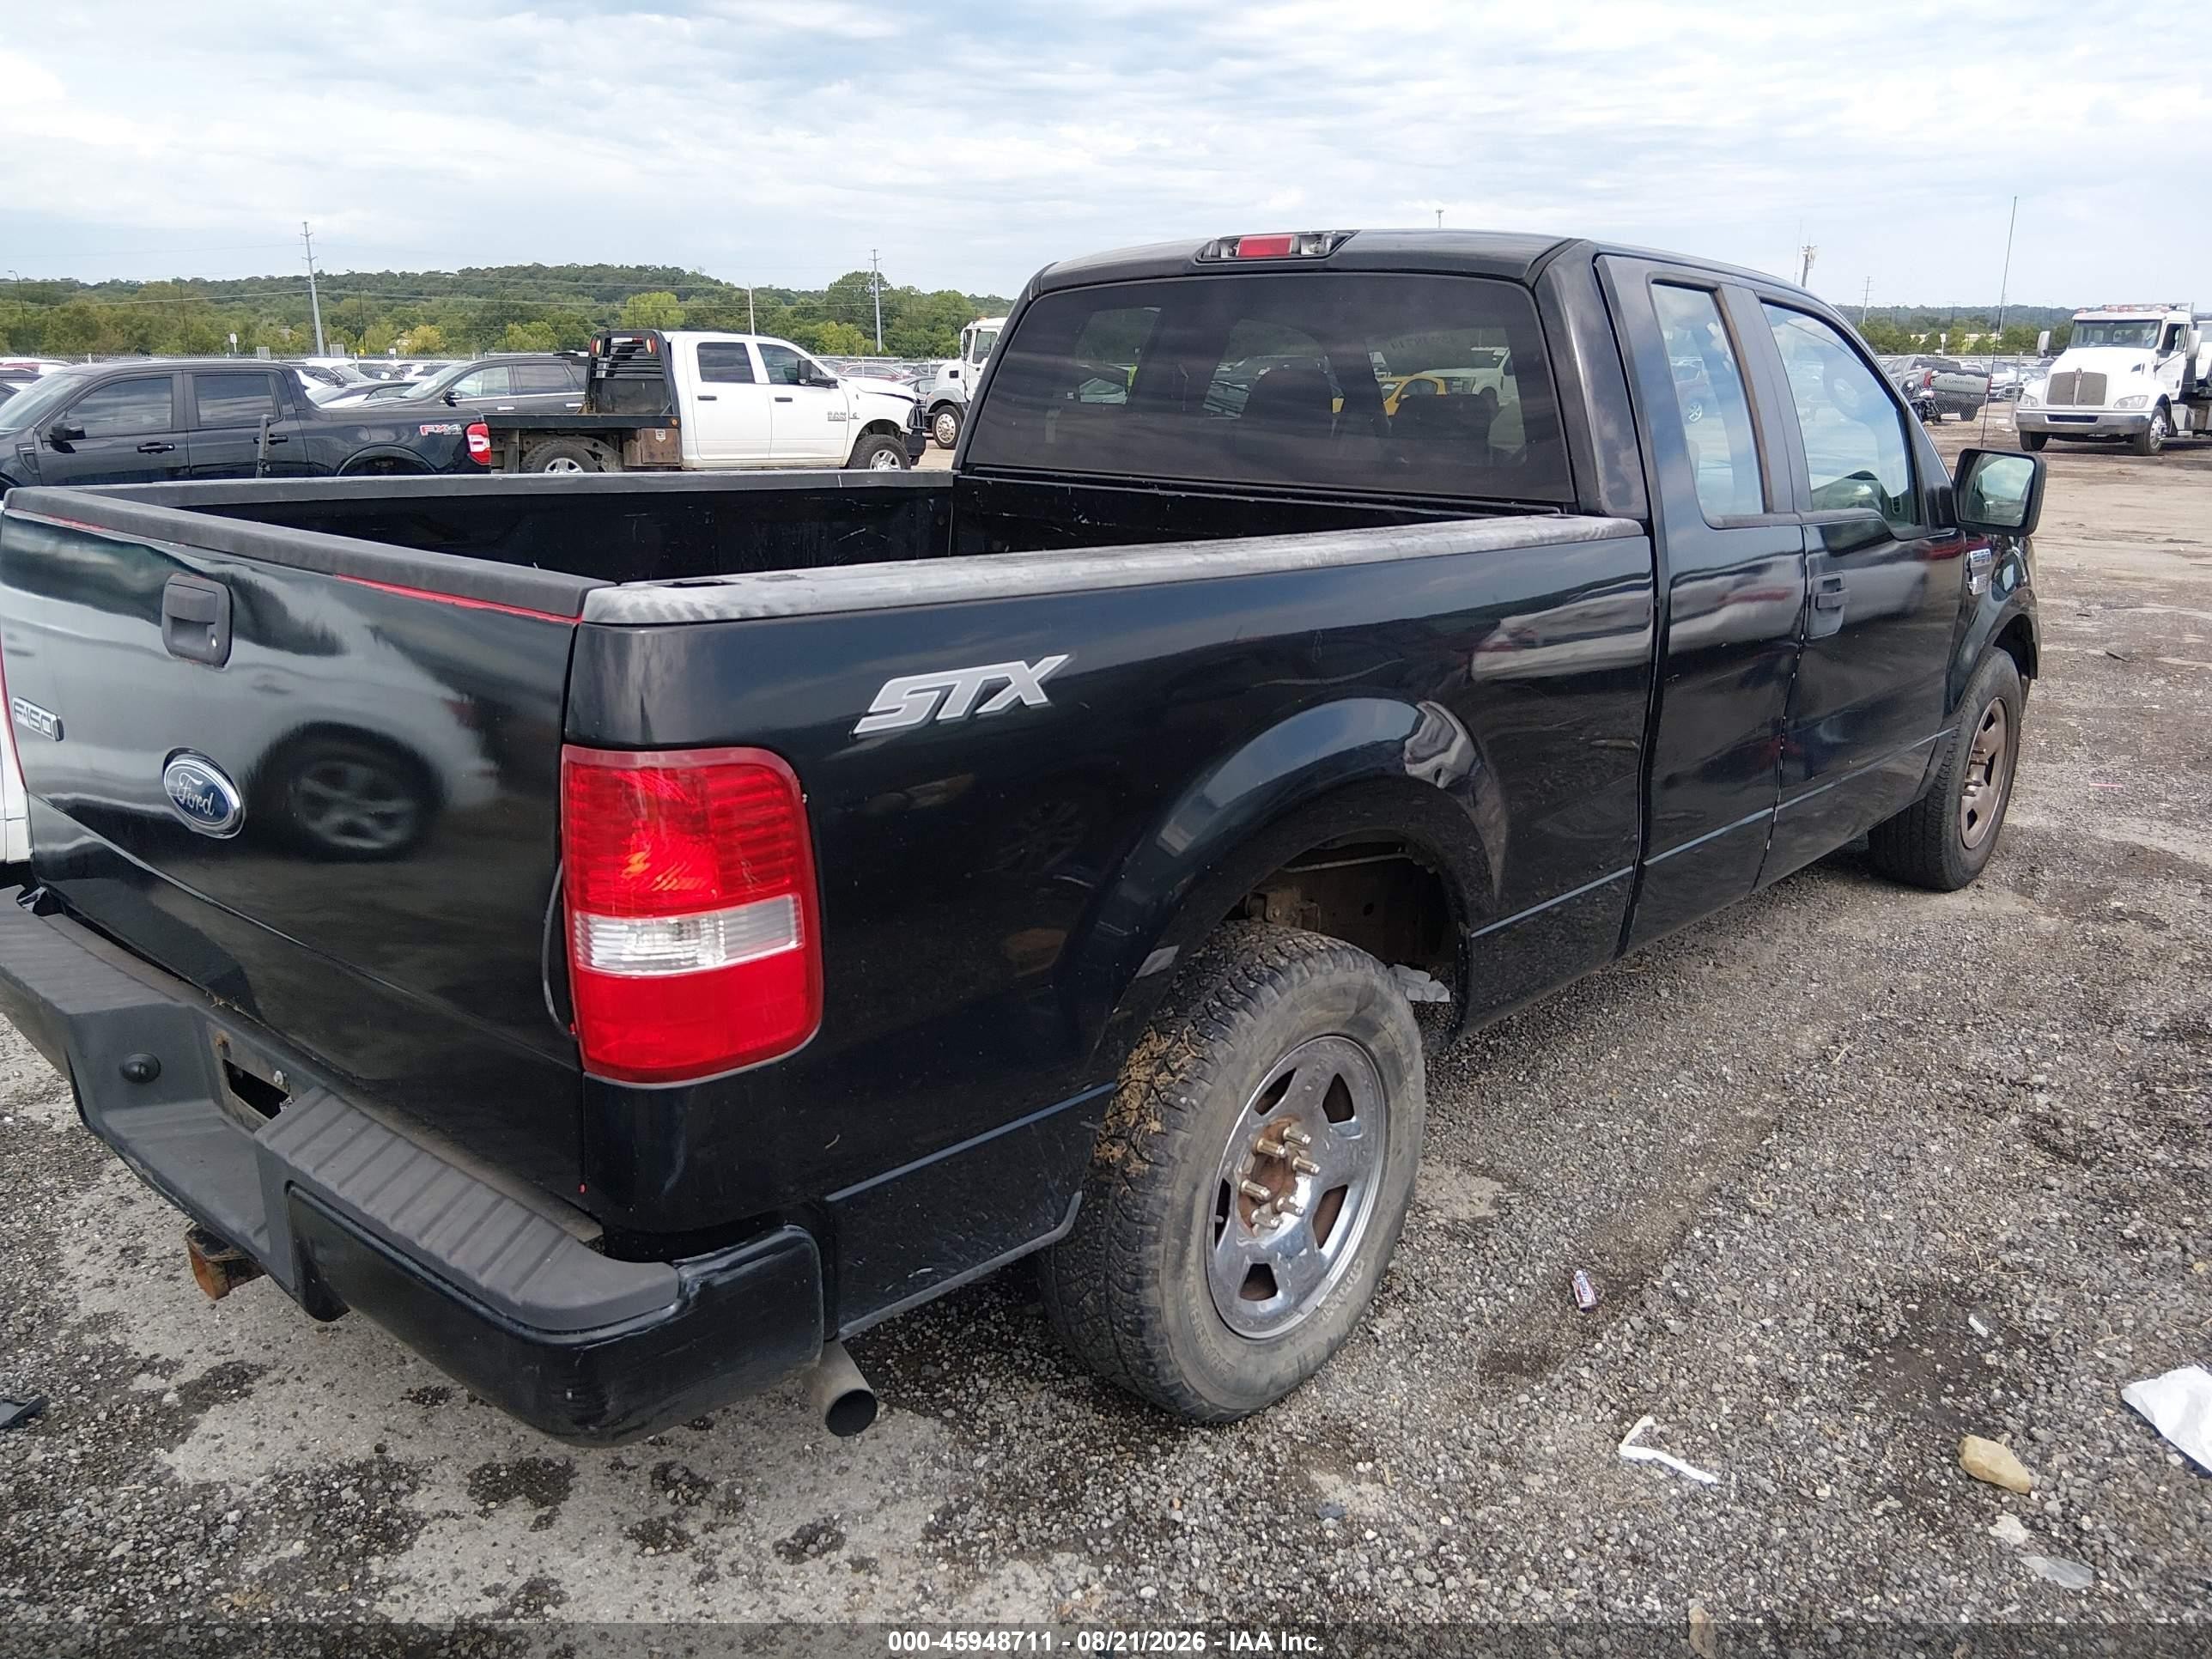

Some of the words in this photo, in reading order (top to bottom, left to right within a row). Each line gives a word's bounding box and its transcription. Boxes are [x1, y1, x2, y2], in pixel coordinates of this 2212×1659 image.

[419, 424, 462, 435] FX4
[852, 653, 1071, 735] STX
[13, 700, 54, 738] F-150
[169, 772, 216, 817] Ford
